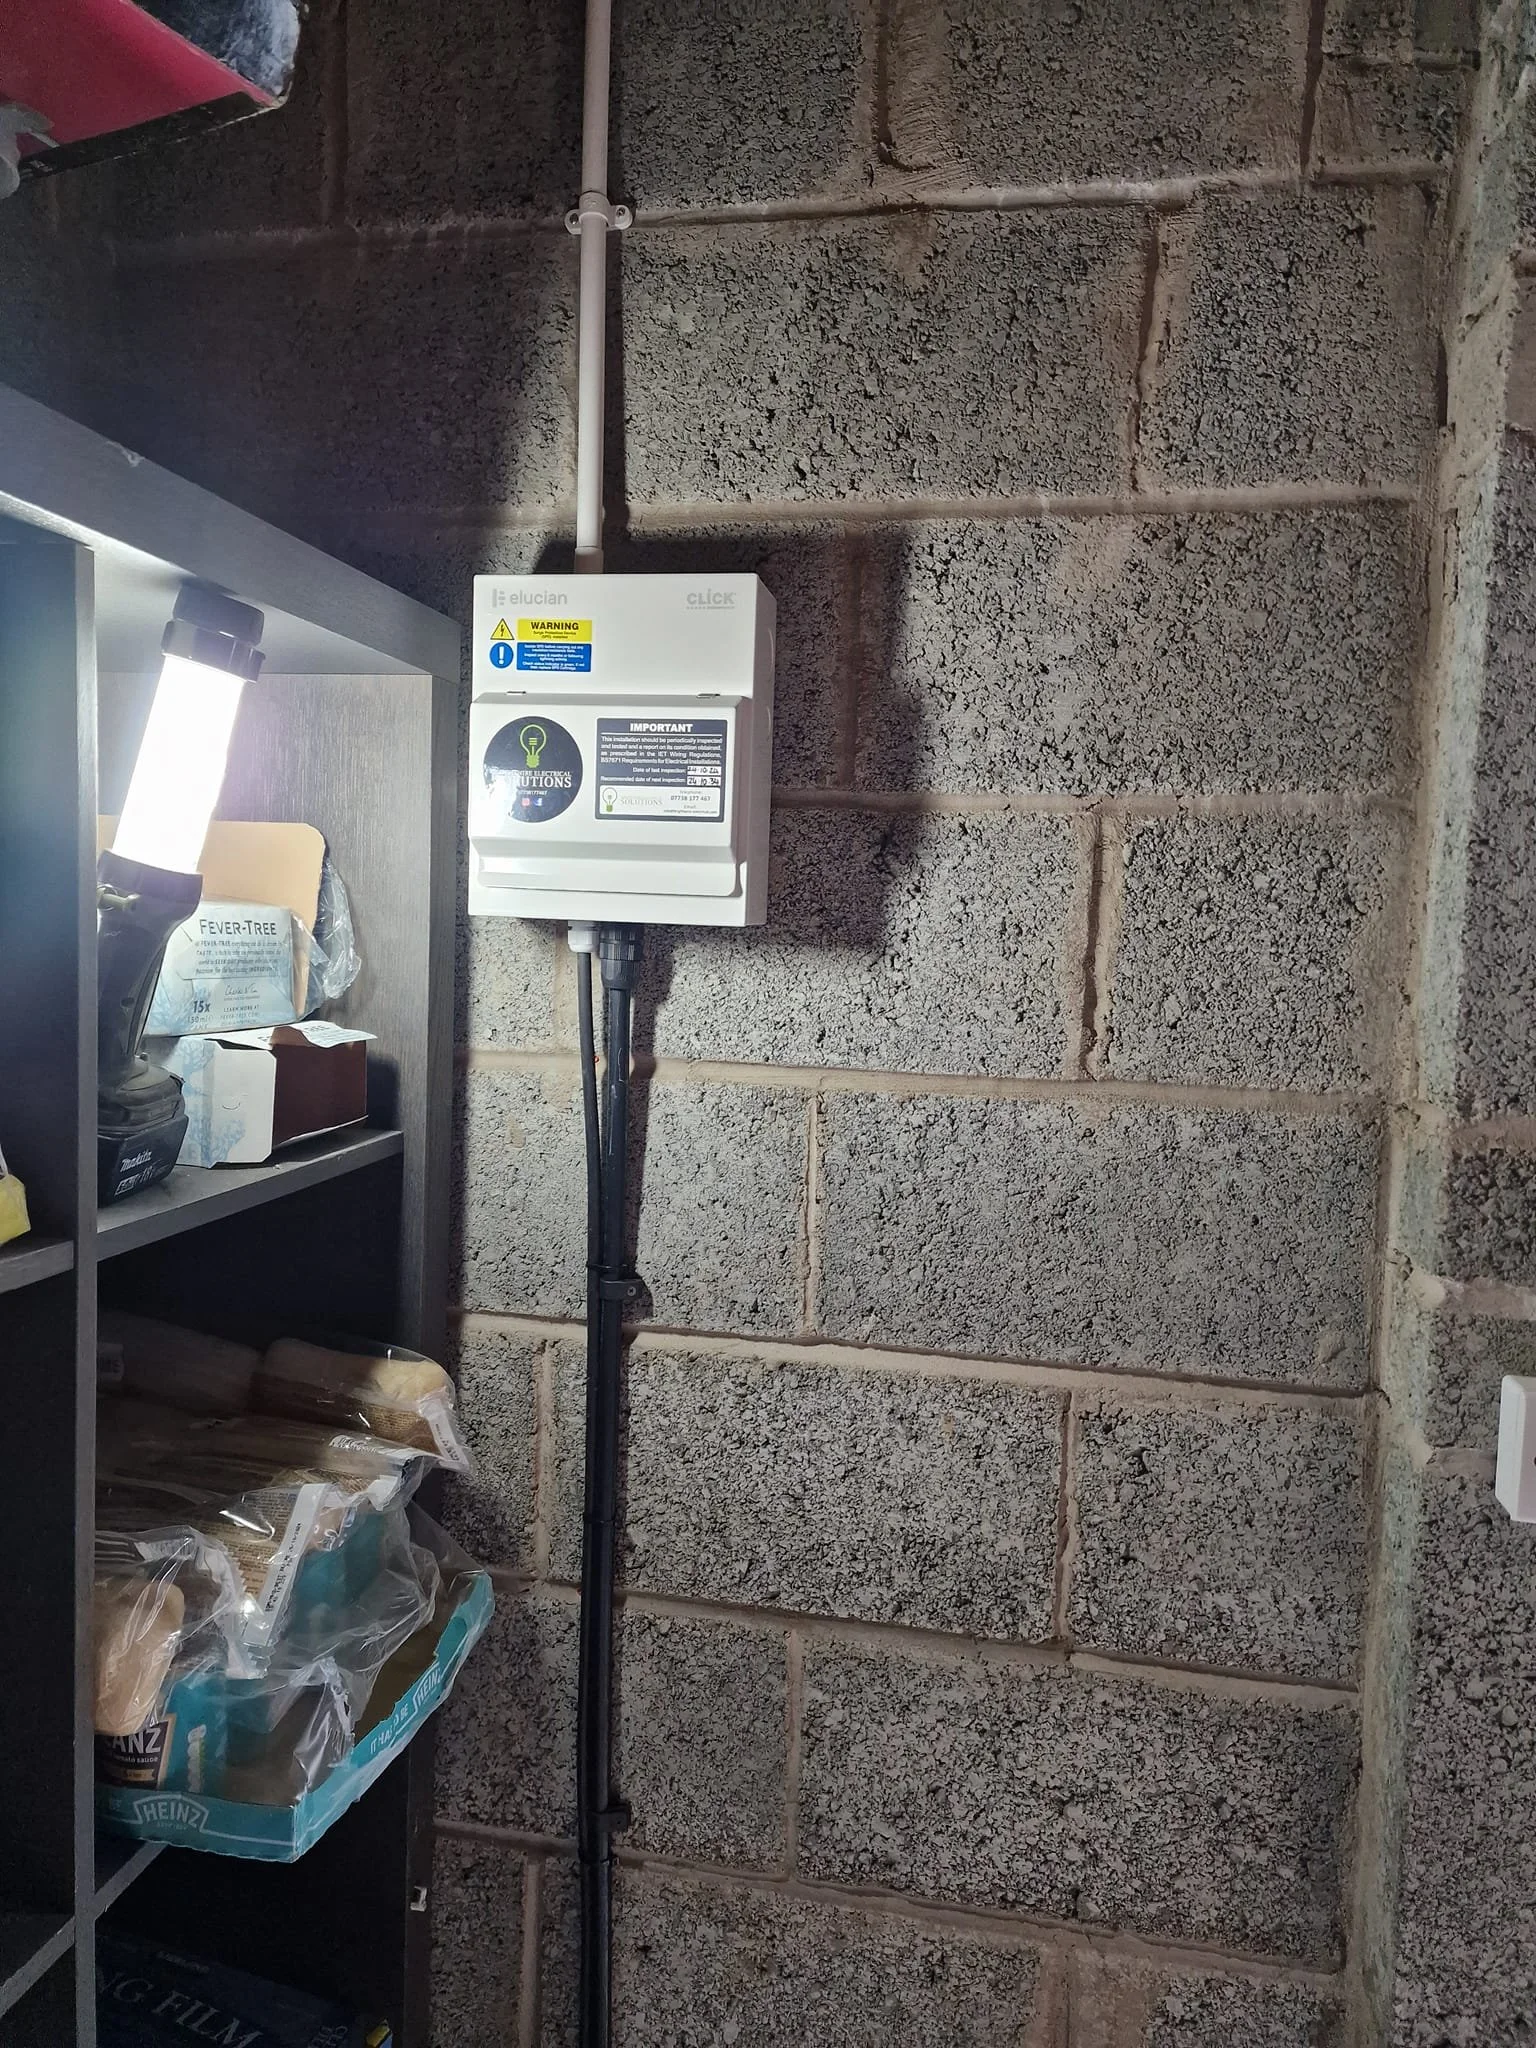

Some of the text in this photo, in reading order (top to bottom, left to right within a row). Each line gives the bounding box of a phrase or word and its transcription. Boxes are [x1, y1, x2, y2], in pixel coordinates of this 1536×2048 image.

[510, 590, 568, 605] elucian
[531, 622, 579, 630] WARNING
[630, 723, 693, 733] IMPORTANT
[199, 919, 277, 935] FEVER-TREE
[193, 1000, 211, 1013] 15x
[143, 1801, 201, 1828] HEINZ
[152, 1990, 265, 2048] FILM
